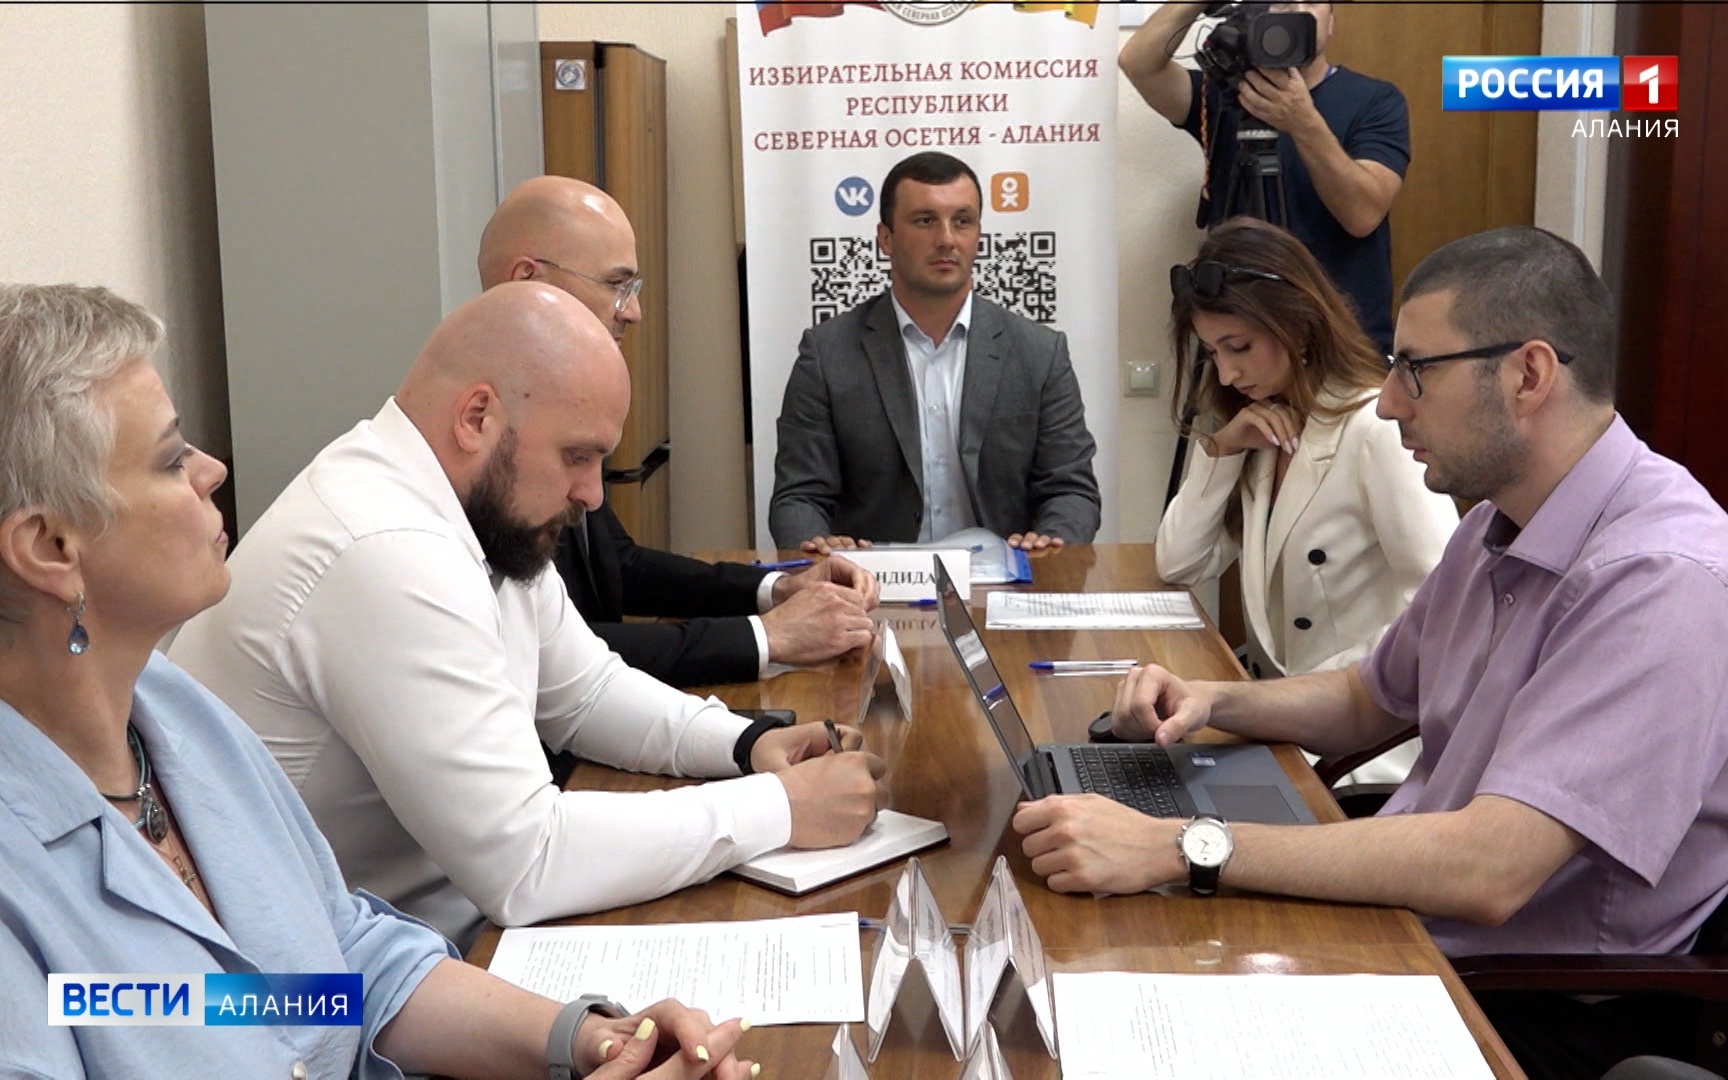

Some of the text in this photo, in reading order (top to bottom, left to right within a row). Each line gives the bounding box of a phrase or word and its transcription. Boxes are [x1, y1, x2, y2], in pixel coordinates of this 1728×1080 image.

[749, 58, 1099, 86] ИЗБИРАТЕЛЬНАЯ КОМИССИЯ
[846, 93, 1008, 116] РЕСПУБЛИКИ
[754, 129, 878, 151] СЕВЕРНАЯ
[885, 126, 981, 147] ОСЕТИЯ
[1002, 123, 1101, 144] АЛАНИЯ
[876, 571, 936, 586] НДИДА
